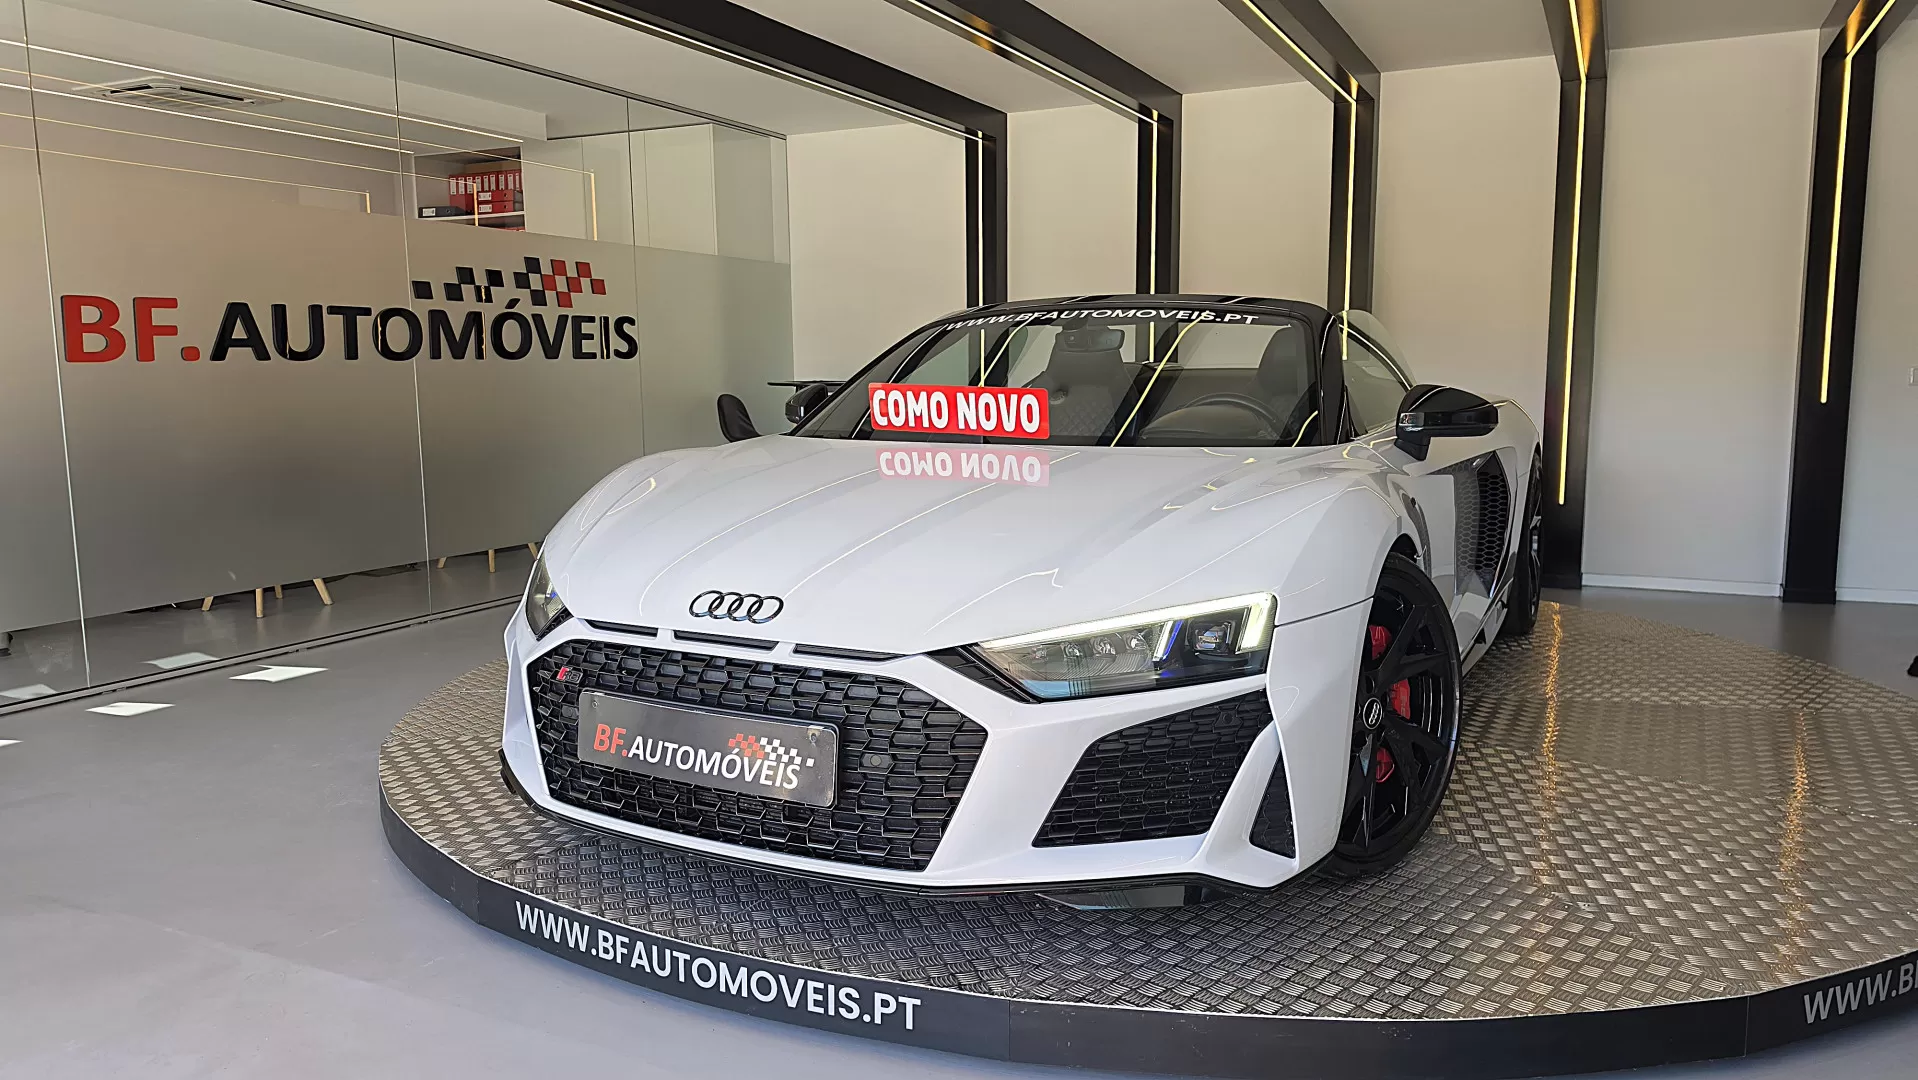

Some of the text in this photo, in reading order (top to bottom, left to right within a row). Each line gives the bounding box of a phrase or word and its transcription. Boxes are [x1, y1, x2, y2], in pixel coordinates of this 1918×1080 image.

[872, 389, 1040, 433] COMO NOVO
[516, 901, 921, 1031] WWW.BFAUTOMOVEIS.PT
